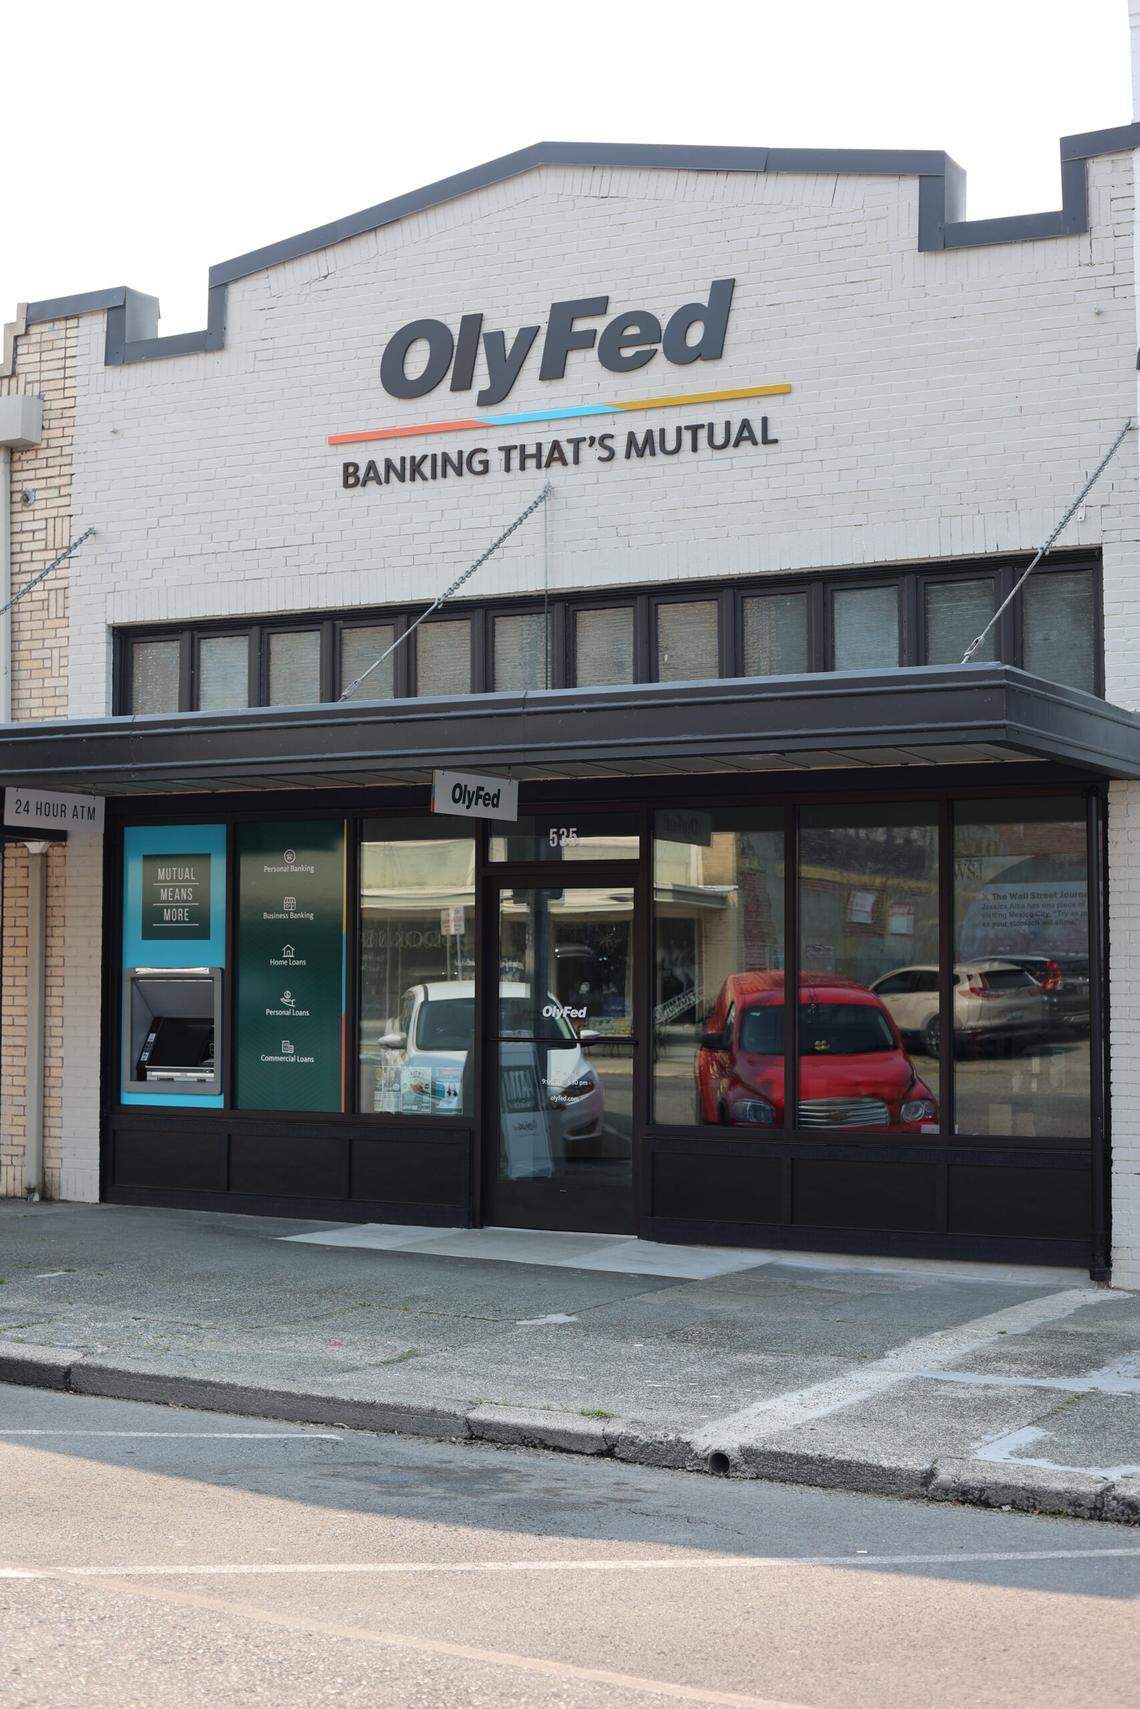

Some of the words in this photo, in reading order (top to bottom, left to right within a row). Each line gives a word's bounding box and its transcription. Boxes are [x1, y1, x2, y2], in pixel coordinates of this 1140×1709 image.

[379, 278, 736, 406] OlyFed
[342, 447, 489, 489] BANKING
[498, 433, 616, 473] THAT'S
[625, 416, 780, 460] MUTUAL
[451, 782, 501, 810] OlyFed
[15, 800, 30, 815] 24
[36, 801, 67, 819] HOUR
[72, 805, 96, 821] ATM
[549, 827, 578, 848] 535
[157, 867, 196, 881] MUTUAL
[263, 865, 289, 873] Personal
[290, 864, 315, 874] Banking
[954, 862, 984, 881] WSJ
[160, 888, 193, 901] MEANS
[992, 893, 1008, 901] The
[1009, 892, 1029, 900] Wall
[1030, 891, 1057, 900] Street
[163, 908, 189, 921] MORE
[289, 911, 315, 921] Banking
[265, 1008, 291, 1016] Personal
[292, 1009, 310, 1017] Loans
[542, 1005, 588, 1020] OlyFed
[260, 1054, 296, 1063] Commercial
[296, 1055, 315, 1063] Loans
[550, 1094, 580, 1103] olyfed.com
